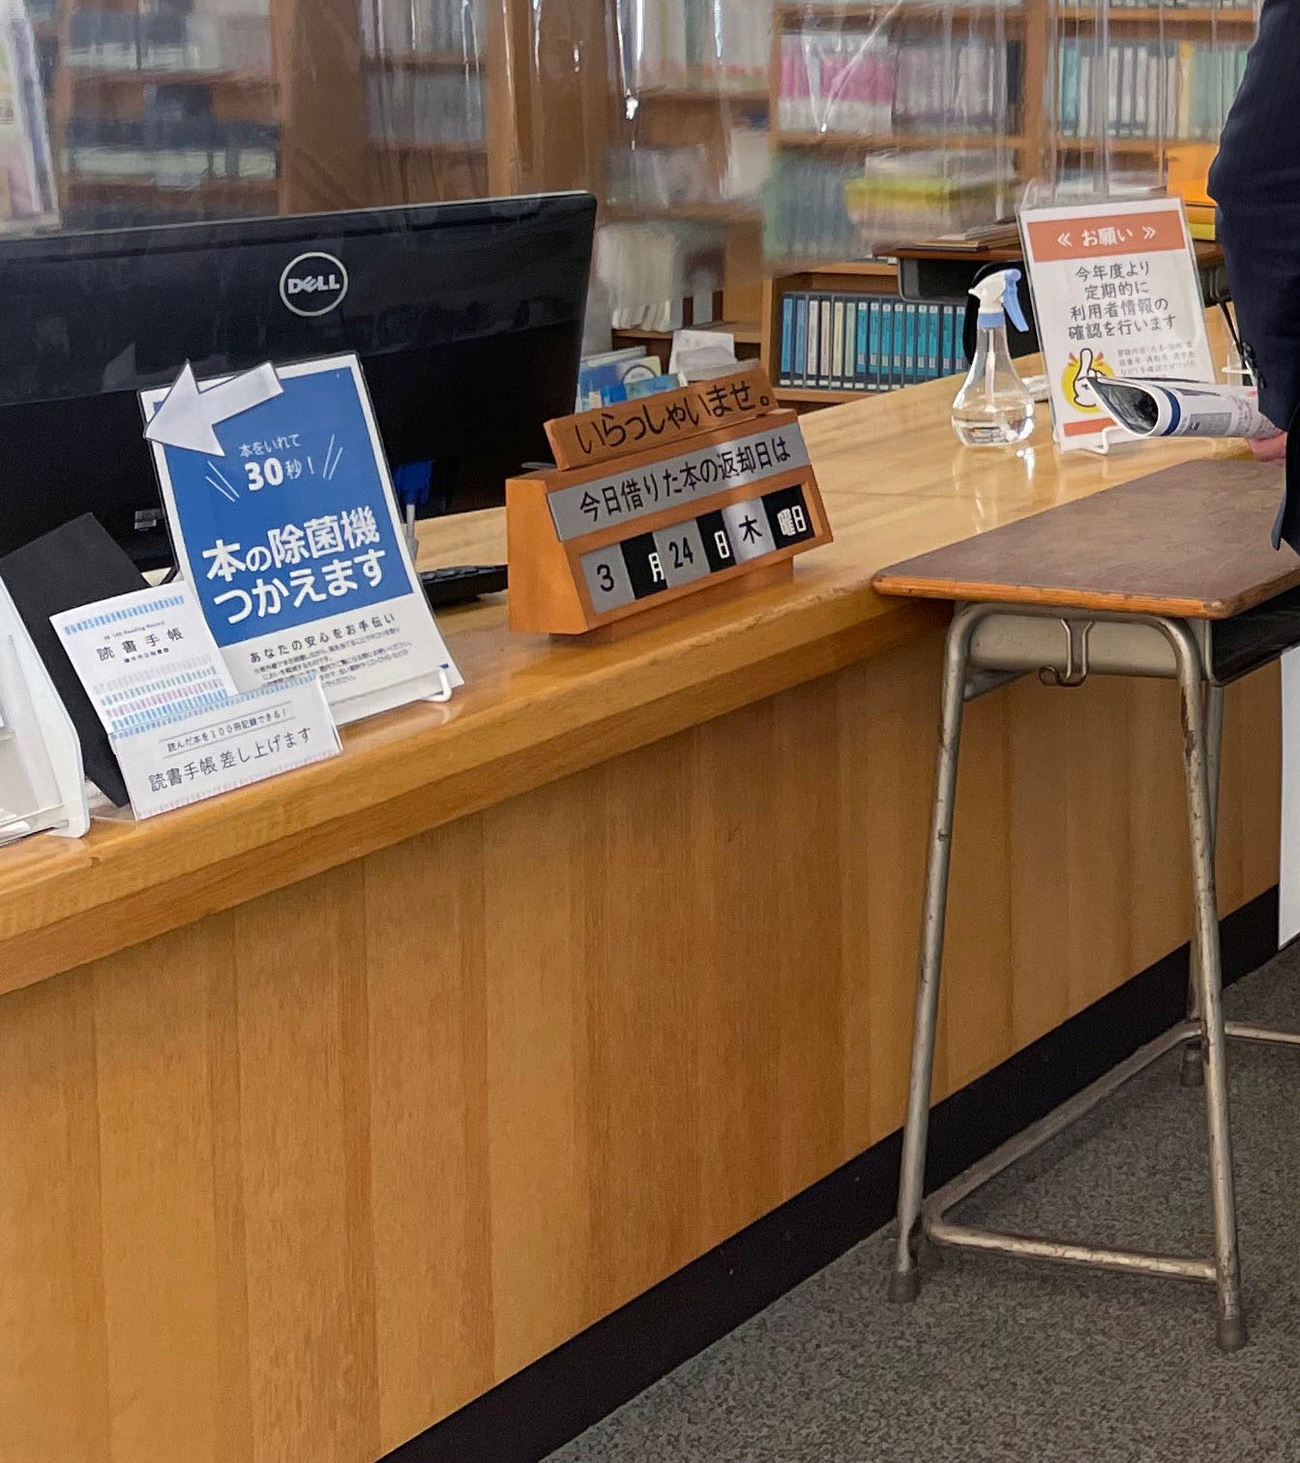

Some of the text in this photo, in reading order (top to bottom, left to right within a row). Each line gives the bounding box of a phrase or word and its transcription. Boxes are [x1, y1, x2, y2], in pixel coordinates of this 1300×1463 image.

[1081, 227, 1133, 247] お願い
[288, 274, 340, 294] DELL
[1075, 261, 1149, 282] 今年度より
[1084, 281, 1149, 301] 定期的に
[1070, 297, 1169, 322] 利用者情報の
[1067, 314, 1176, 340] 確認を行います
[575, 380, 770, 455] いらっしゃいませ。
[239, 433, 301, 459] 本をいれて
[580, 436, 791, 522] 今日借りた本の返却日は
[202, 505, 381, 583] 本の除菌機
[213, 548, 387, 624] つかえます
[97, 626, 185, 662] 読書手帳
[249, 611, 396, 664] あなたの安心をお手伝い
[147, 725, 313, 794] 読書手帳差し上げます
